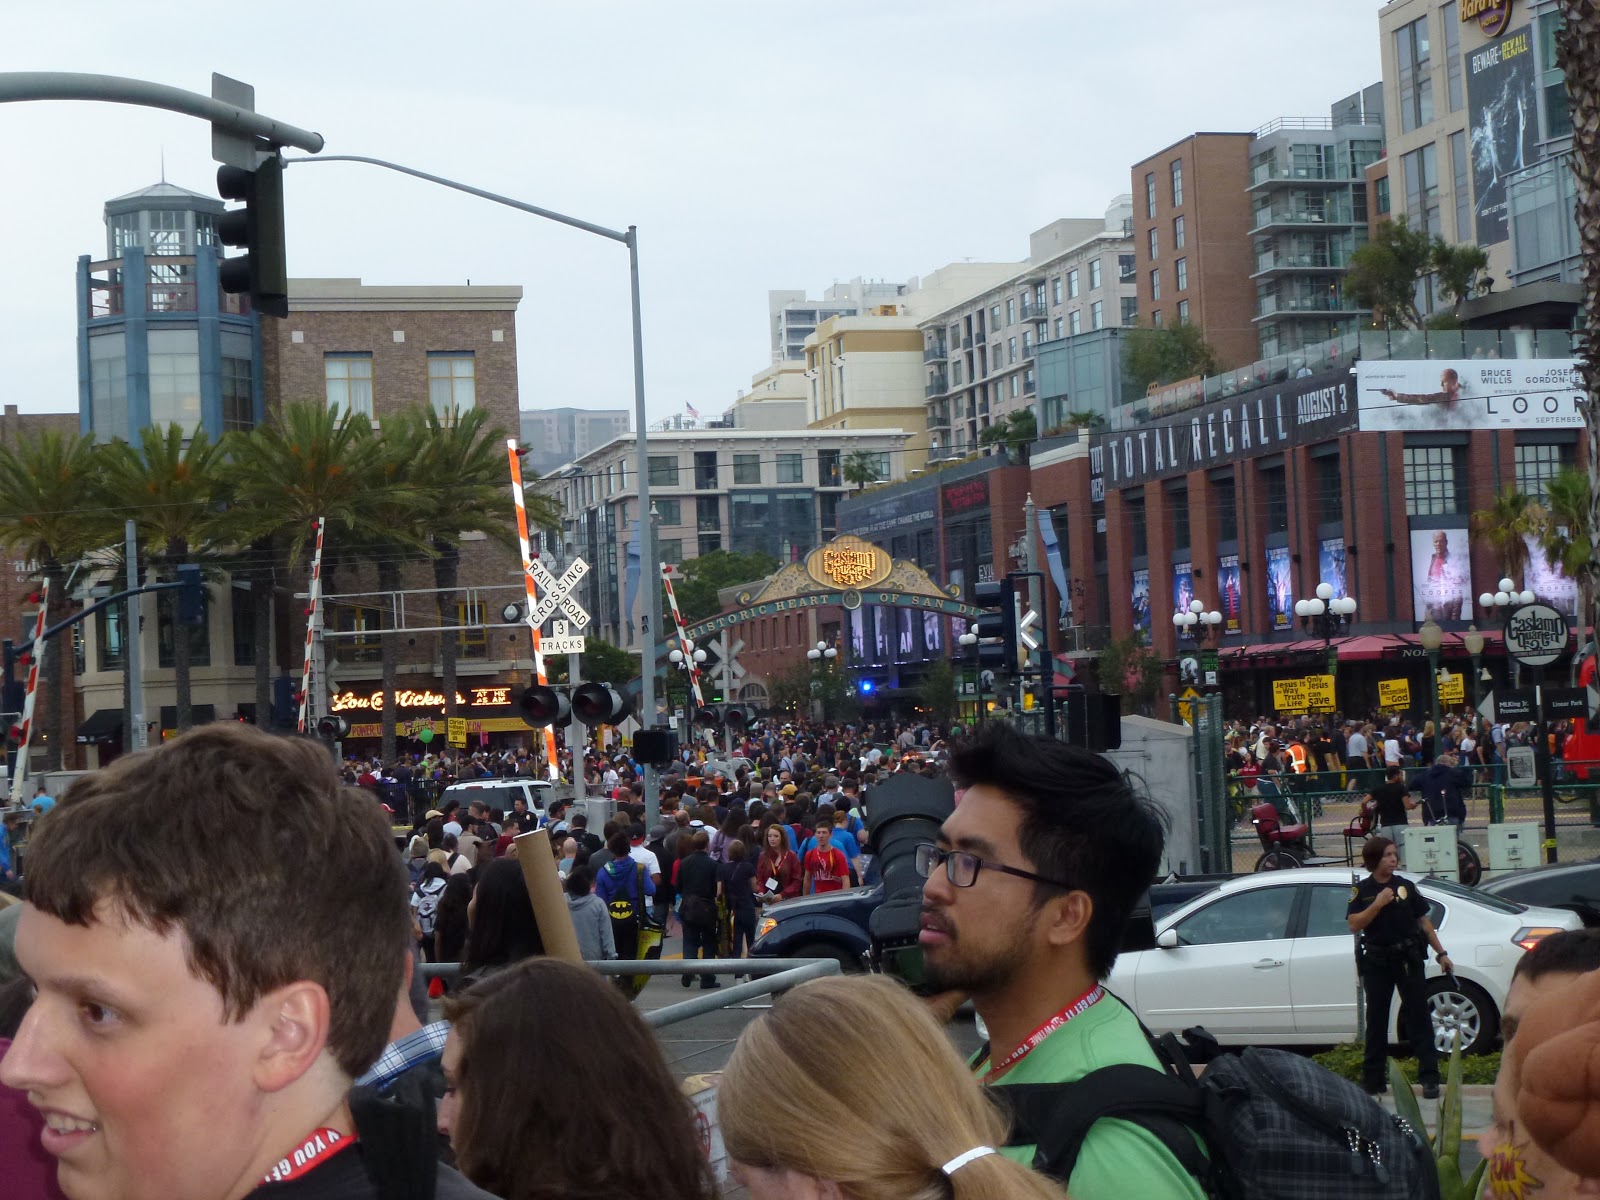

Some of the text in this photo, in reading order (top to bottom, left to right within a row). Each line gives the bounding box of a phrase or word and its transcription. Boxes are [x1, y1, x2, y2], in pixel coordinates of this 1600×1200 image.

[1481, 14, 1499, 28] HOTEL
[1472, 46, 1499, 74] BEWARE
[1481, 369, 1512, 377] BRUCE
[1535, 416, 1582, 424] SEPTEMBER
[1110, 383, 1348, 481] TOTAL RECALL AUGUST 3
[824, 546, 875, 574] Gaslamp
[529, 562, 586, 626] RAIL ROAD
[531, 564, 583, 624] CROSSING
[686, 605, 768, 640] HISTORIC
[775, 594, 829, 611] HEART
[879, 593, 899, 603] OF
[911, 595, 944, 609] SAN
[557, 622, 564, 635] 3
[1508, 610, 1565, 640] Gaslamp
[541, 640, 582, 651] TRACKS
[1517, 631, 1560, 650] Quarter
[1283, 687, 1299, 695] Way
[1308, 682, 1329, 690] Jesus
[331, 691, 370, 712] Lou
[1284, 693, 1306, 701] Truth
[1391, 694, 1408, 703] God
[352, 725, 375, 737] POWER
[1073, 999, 1089, 1015] GET
[1064, 1009, 1075, 1021] IT
[293, 1134, 327, 1167] YOU
